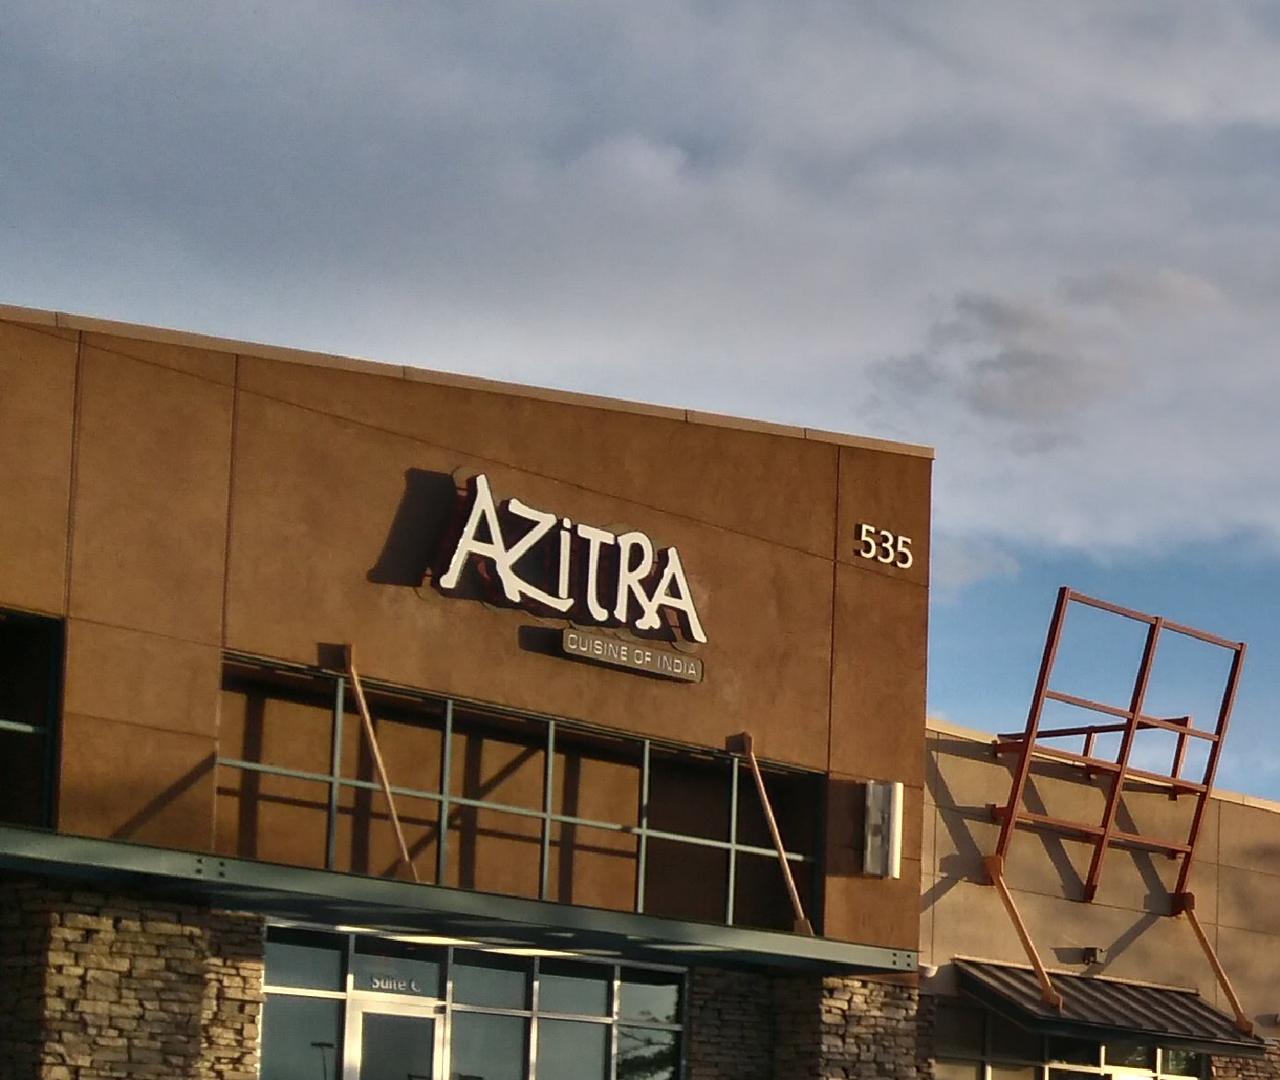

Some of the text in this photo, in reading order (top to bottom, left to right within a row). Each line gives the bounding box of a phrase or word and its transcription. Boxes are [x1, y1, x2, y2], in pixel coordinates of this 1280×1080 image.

[860, 523, 913, 569] 535
[567, 634, 698, 675] CUISINE OF INDIA
